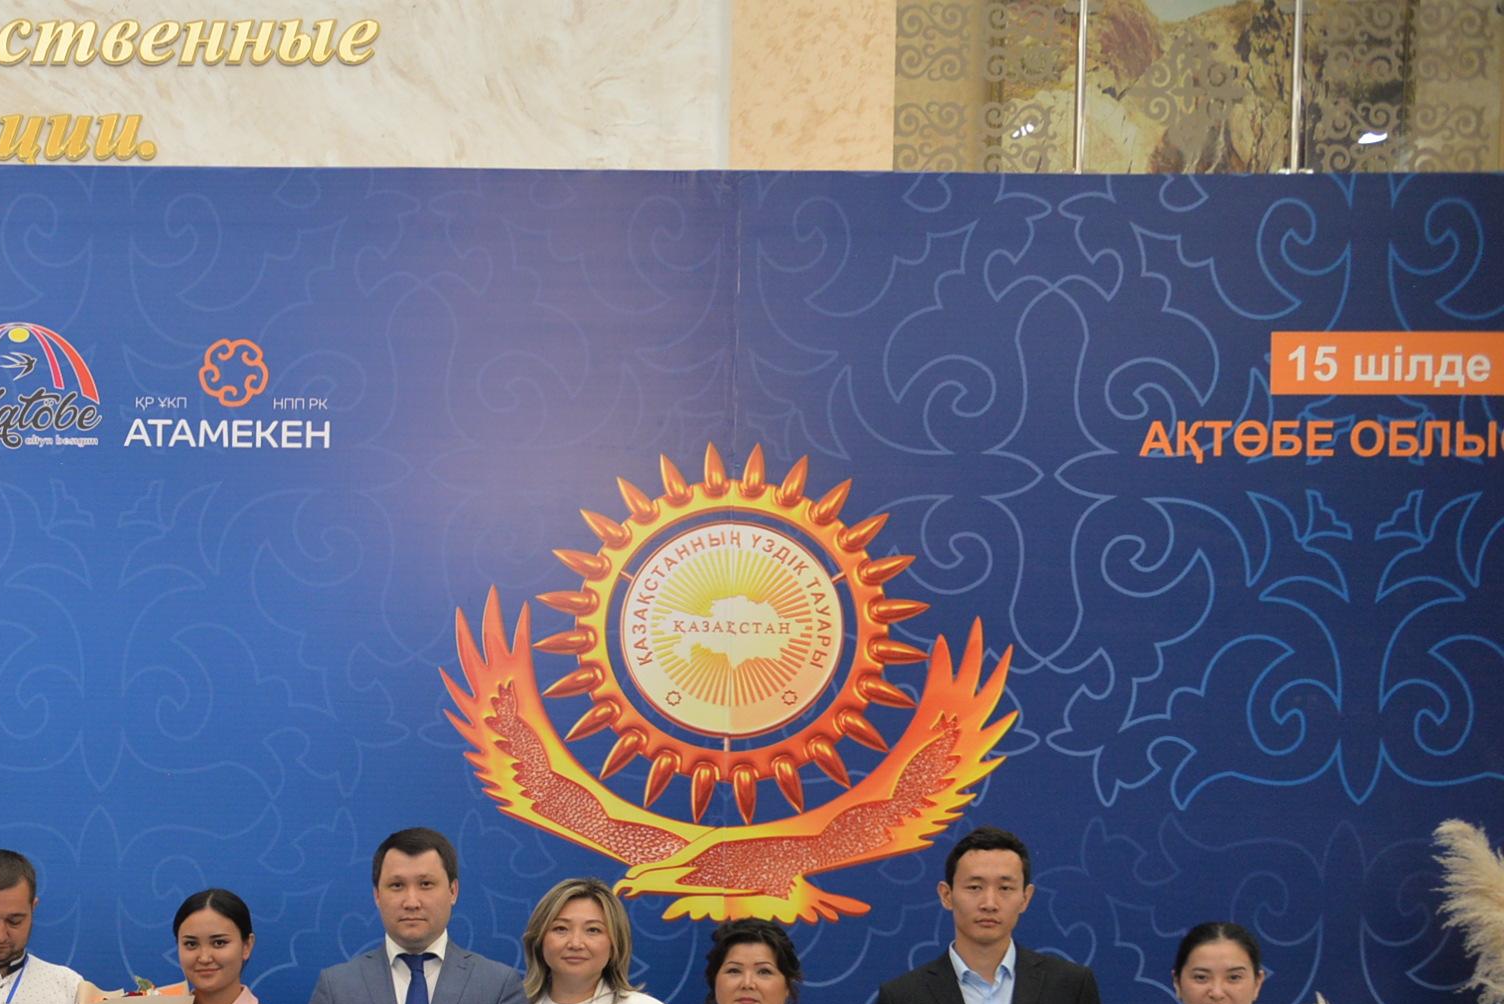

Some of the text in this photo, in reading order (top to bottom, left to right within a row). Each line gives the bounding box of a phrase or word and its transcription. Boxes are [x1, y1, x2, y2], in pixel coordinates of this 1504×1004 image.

[1287, 345, 1492, 388] 15 шілде
[135, 396, 155, 411] ҚР
[273, 397, 328, 410] НПП РК
[123, 418, 331, 449] АТАМЕКЕН
[1139, 419, 1504, 465] АҚТӨБЕ ОБЛЫ
[631, 530, 832, 669] ҚАЗАҚСТАННЫҢ ҮЗДІК ТАУАРЫ
[673, 620, 792, 636] ҚАЗАҚСТАН
